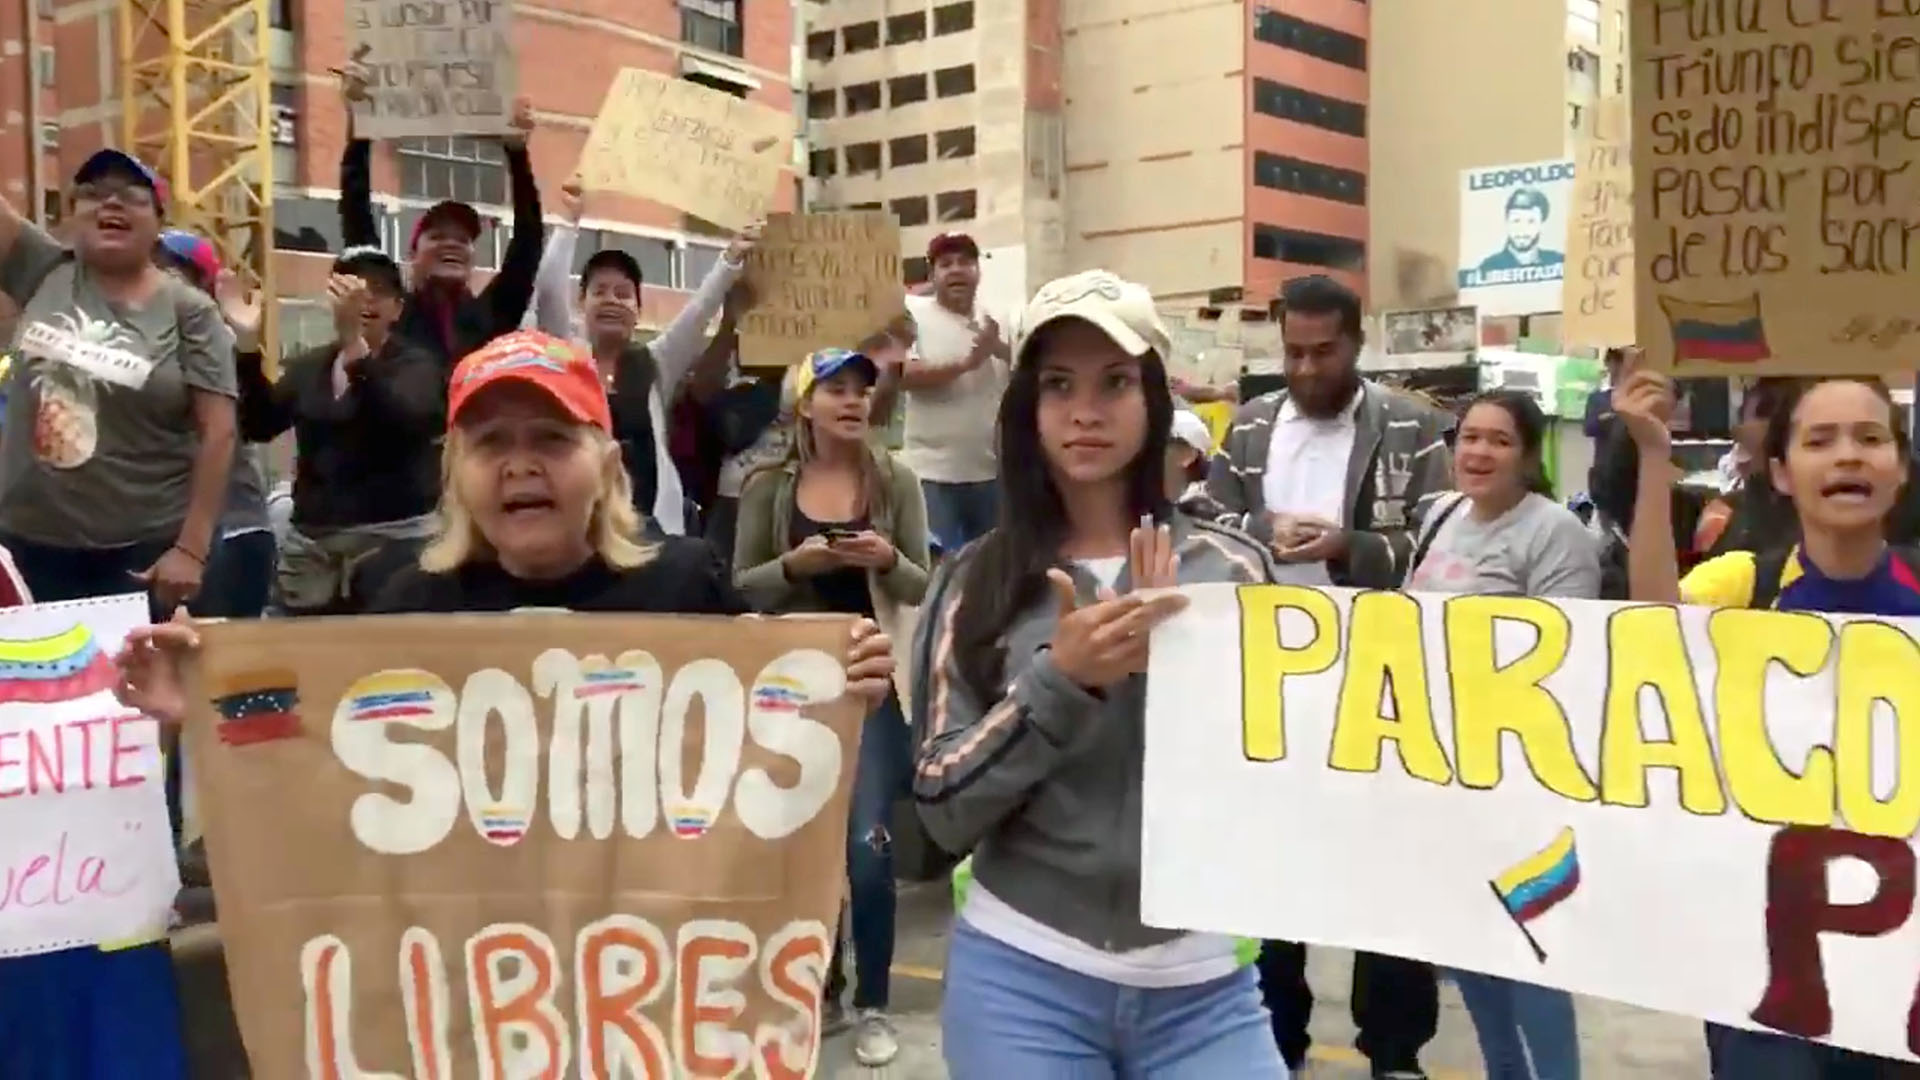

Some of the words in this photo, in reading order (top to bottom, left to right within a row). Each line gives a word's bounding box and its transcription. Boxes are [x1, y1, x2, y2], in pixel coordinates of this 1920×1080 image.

[1580, 283, 1616, 316] de
[1651, 226, 1706, 284] de
[331, 648, 848, 855] SOMOS
[1236, 582, 1920, 839] PARACO
[300, 913, 831, 1080] LIBRES
